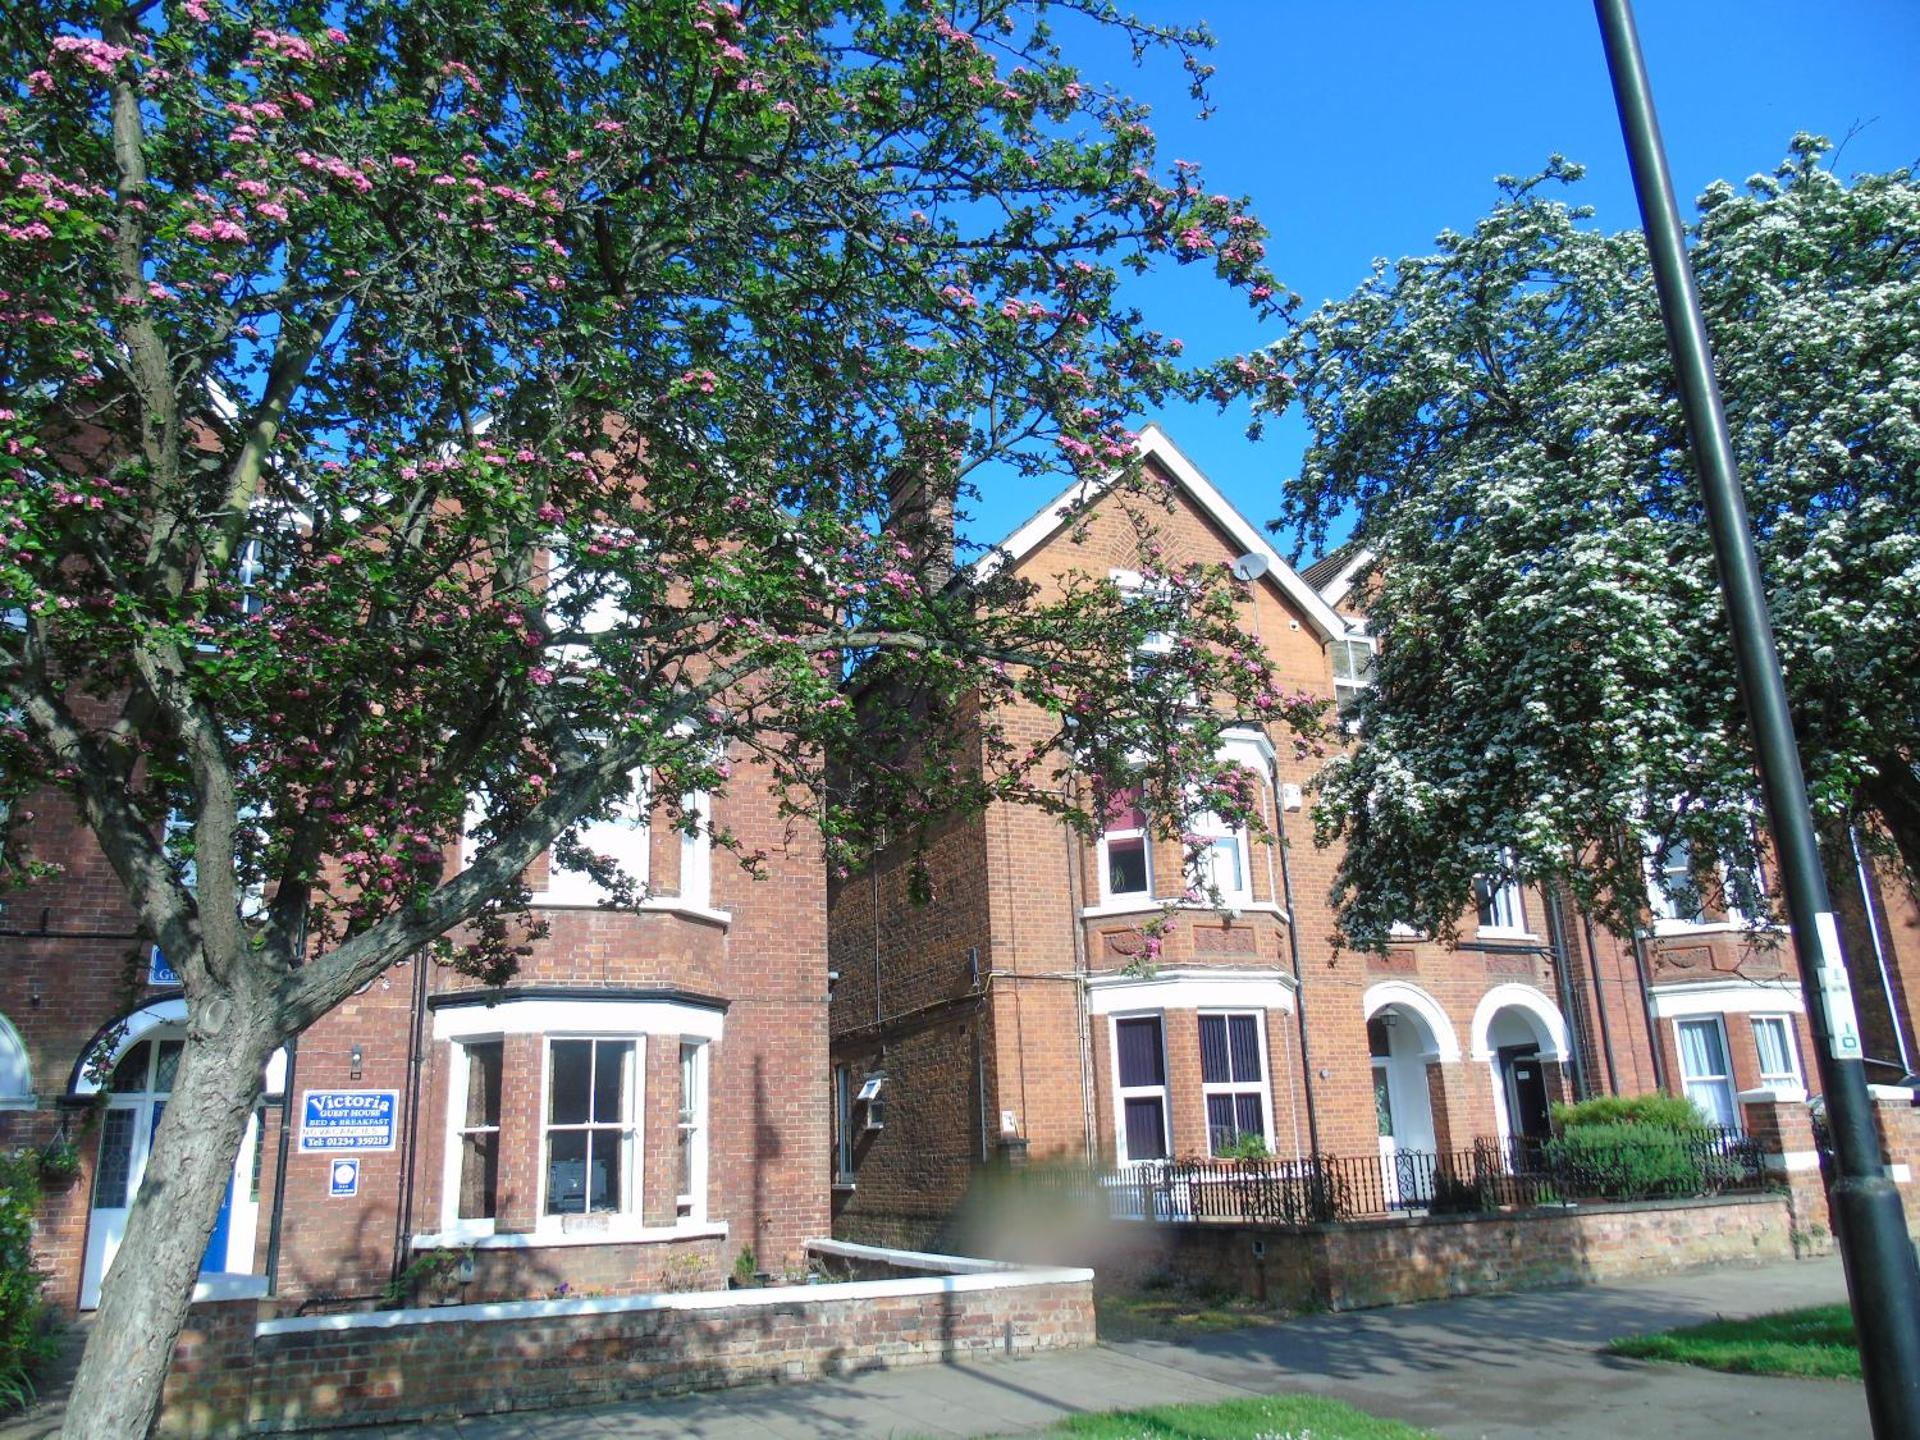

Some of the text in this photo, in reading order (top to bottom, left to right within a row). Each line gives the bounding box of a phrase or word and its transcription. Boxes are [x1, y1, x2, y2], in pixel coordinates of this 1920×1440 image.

[310, 1095, 389, 1112] Victoria
[320, 1109, 380, 1117] GUEST HOUSE
[307, 1137, 324, 1146] Tel:
[326, 1137, 355, 1146] 01234
